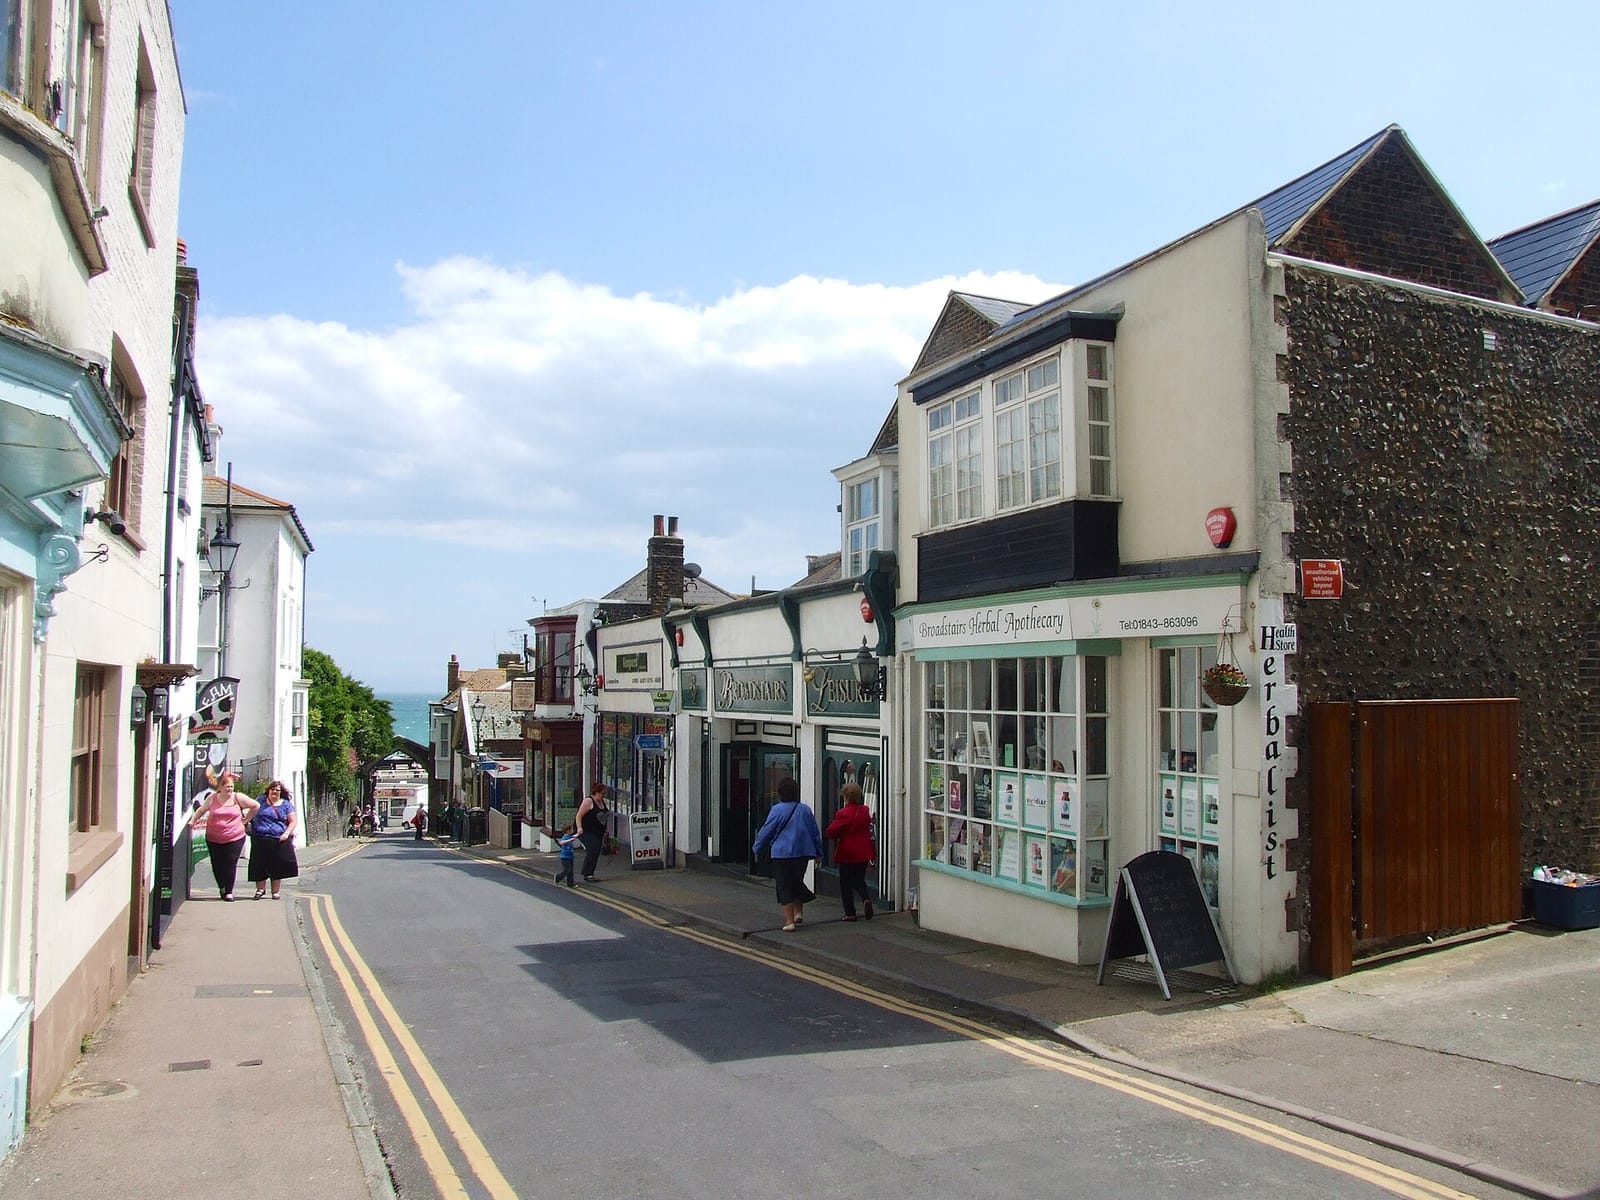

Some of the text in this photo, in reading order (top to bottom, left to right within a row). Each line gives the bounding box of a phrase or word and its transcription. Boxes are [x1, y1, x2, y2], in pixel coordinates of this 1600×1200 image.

[919, 605, 1064, 639] Broadstairs Herbal Apothecary
[1275, 640, 1295, 651] Store
[632, 816, 659, 824] Keepers
[635, 848, 661, 858] OPEN
